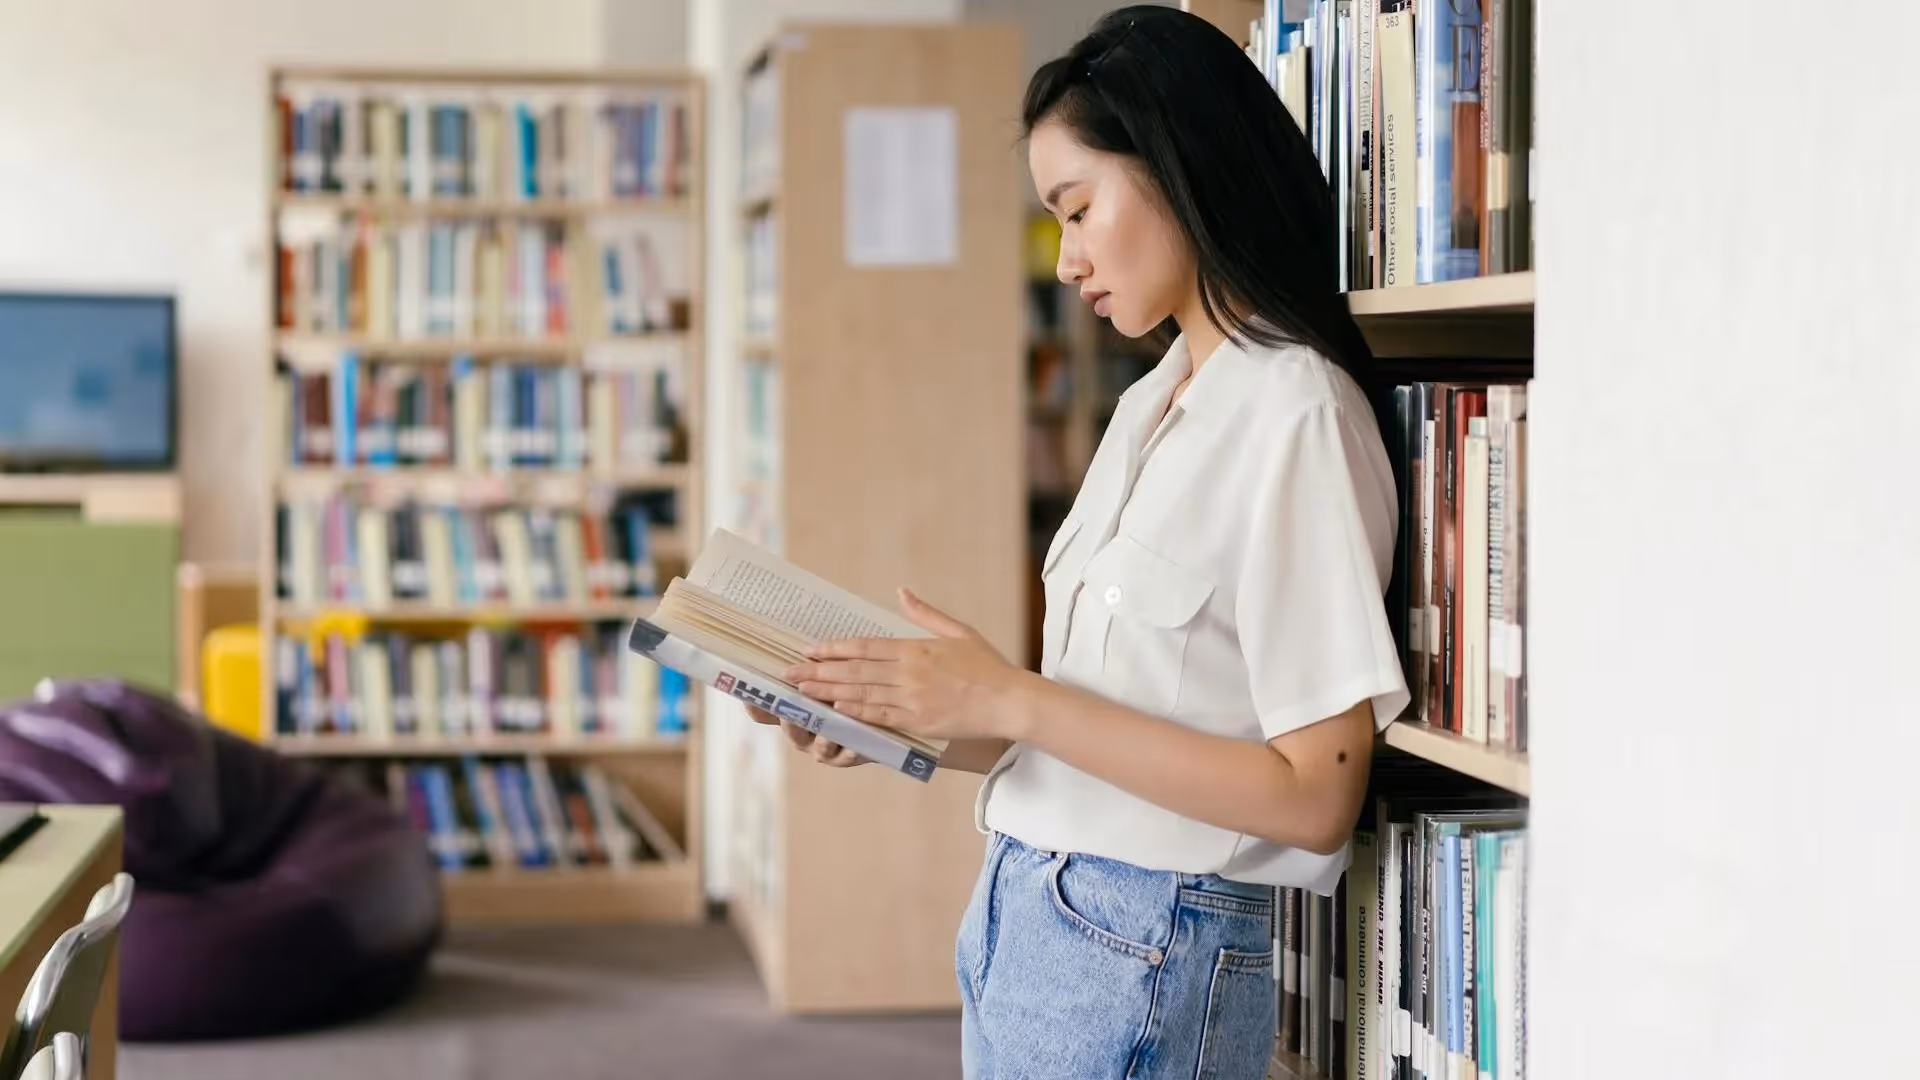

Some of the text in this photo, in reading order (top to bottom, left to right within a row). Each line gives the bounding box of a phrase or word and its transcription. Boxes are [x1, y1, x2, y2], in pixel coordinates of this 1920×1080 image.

[1385, 16, 1399, 28] 363
[1387, 114, 1397, 285] Other social services
[1358, 905, 1366, 987] commerce
[1460, 838, 1473, 990] INTERNATIONAL
